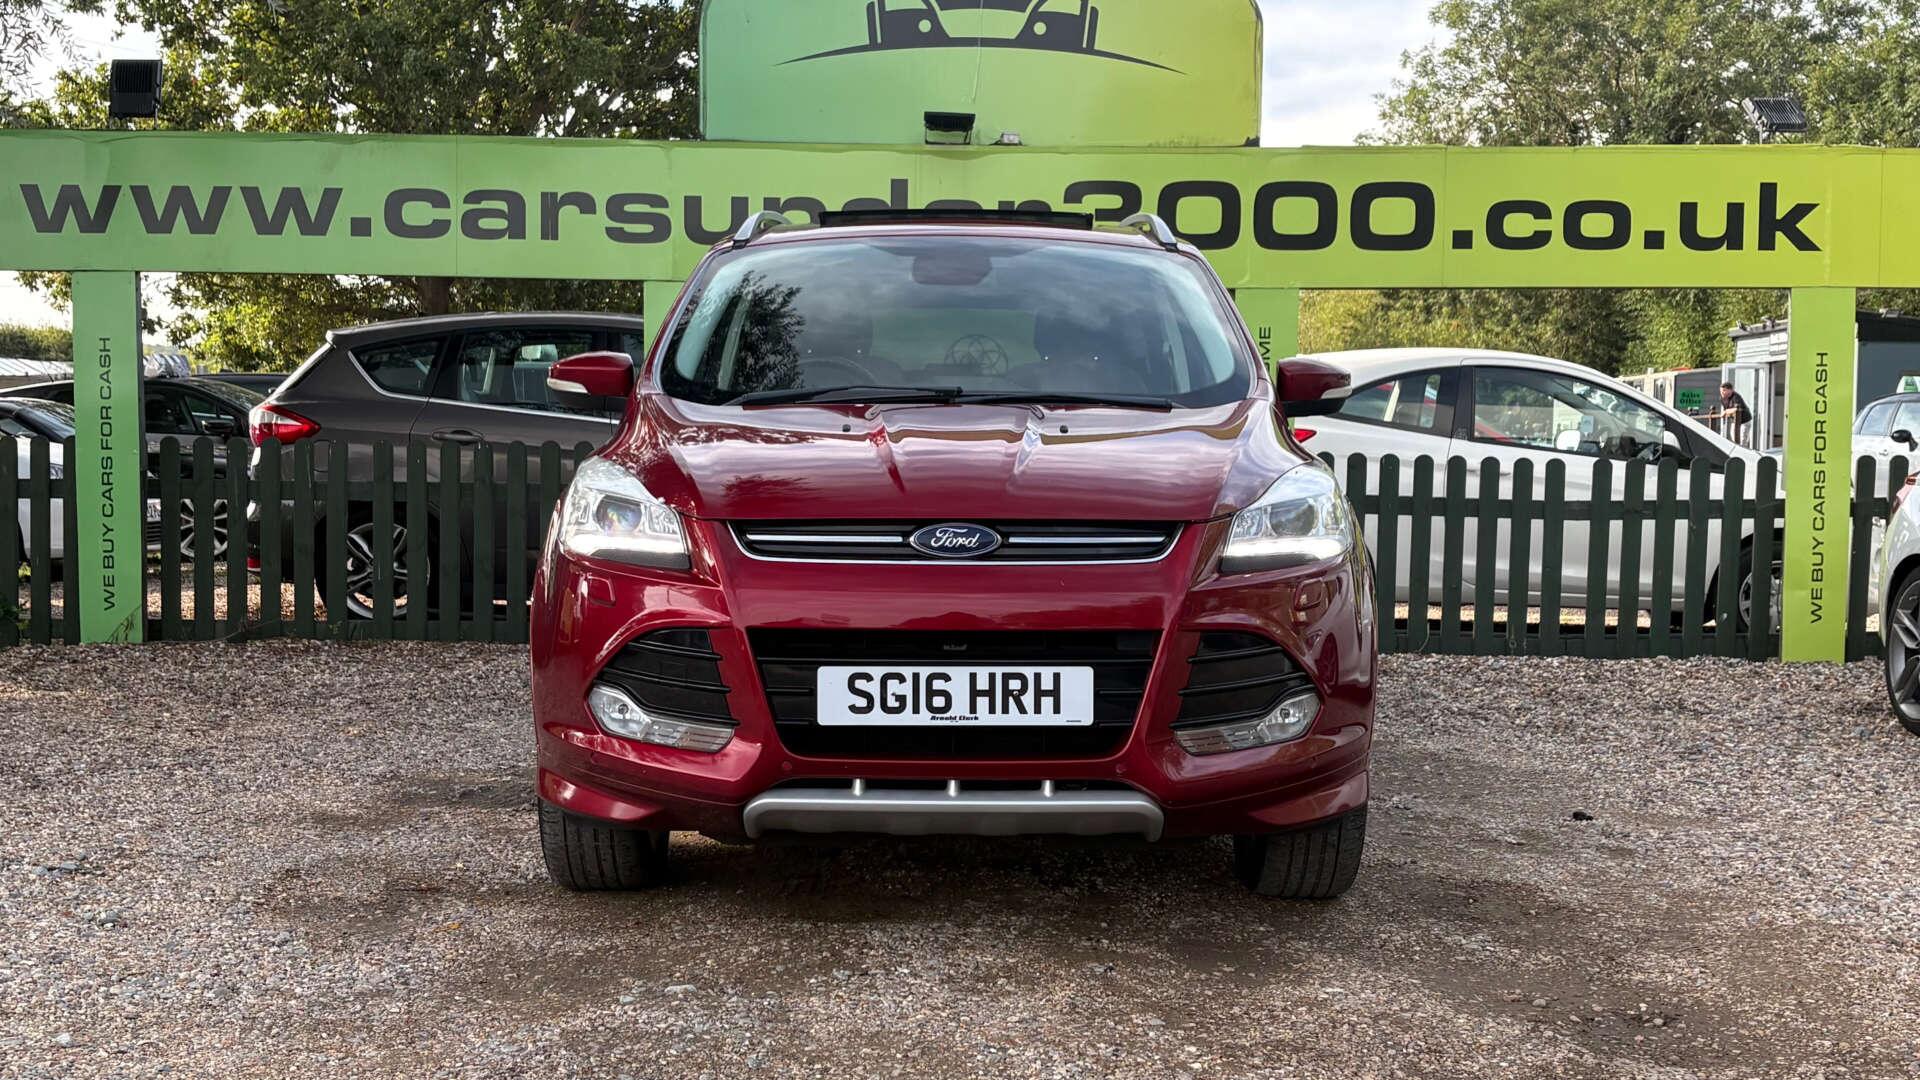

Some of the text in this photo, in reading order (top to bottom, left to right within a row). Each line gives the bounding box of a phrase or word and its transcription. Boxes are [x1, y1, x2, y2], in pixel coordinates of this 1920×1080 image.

[19, 178, 1823, 252] www.carsun3000.co.uk
[99, 337, 116, 612] WE BUY CARS FOR CASH
[1810, 352, 1829, 624] WE BUY CARS FOR CASH
[930, 527, 981, 548] Ford
[847, 672, 1061, 715] SG16 HRH
